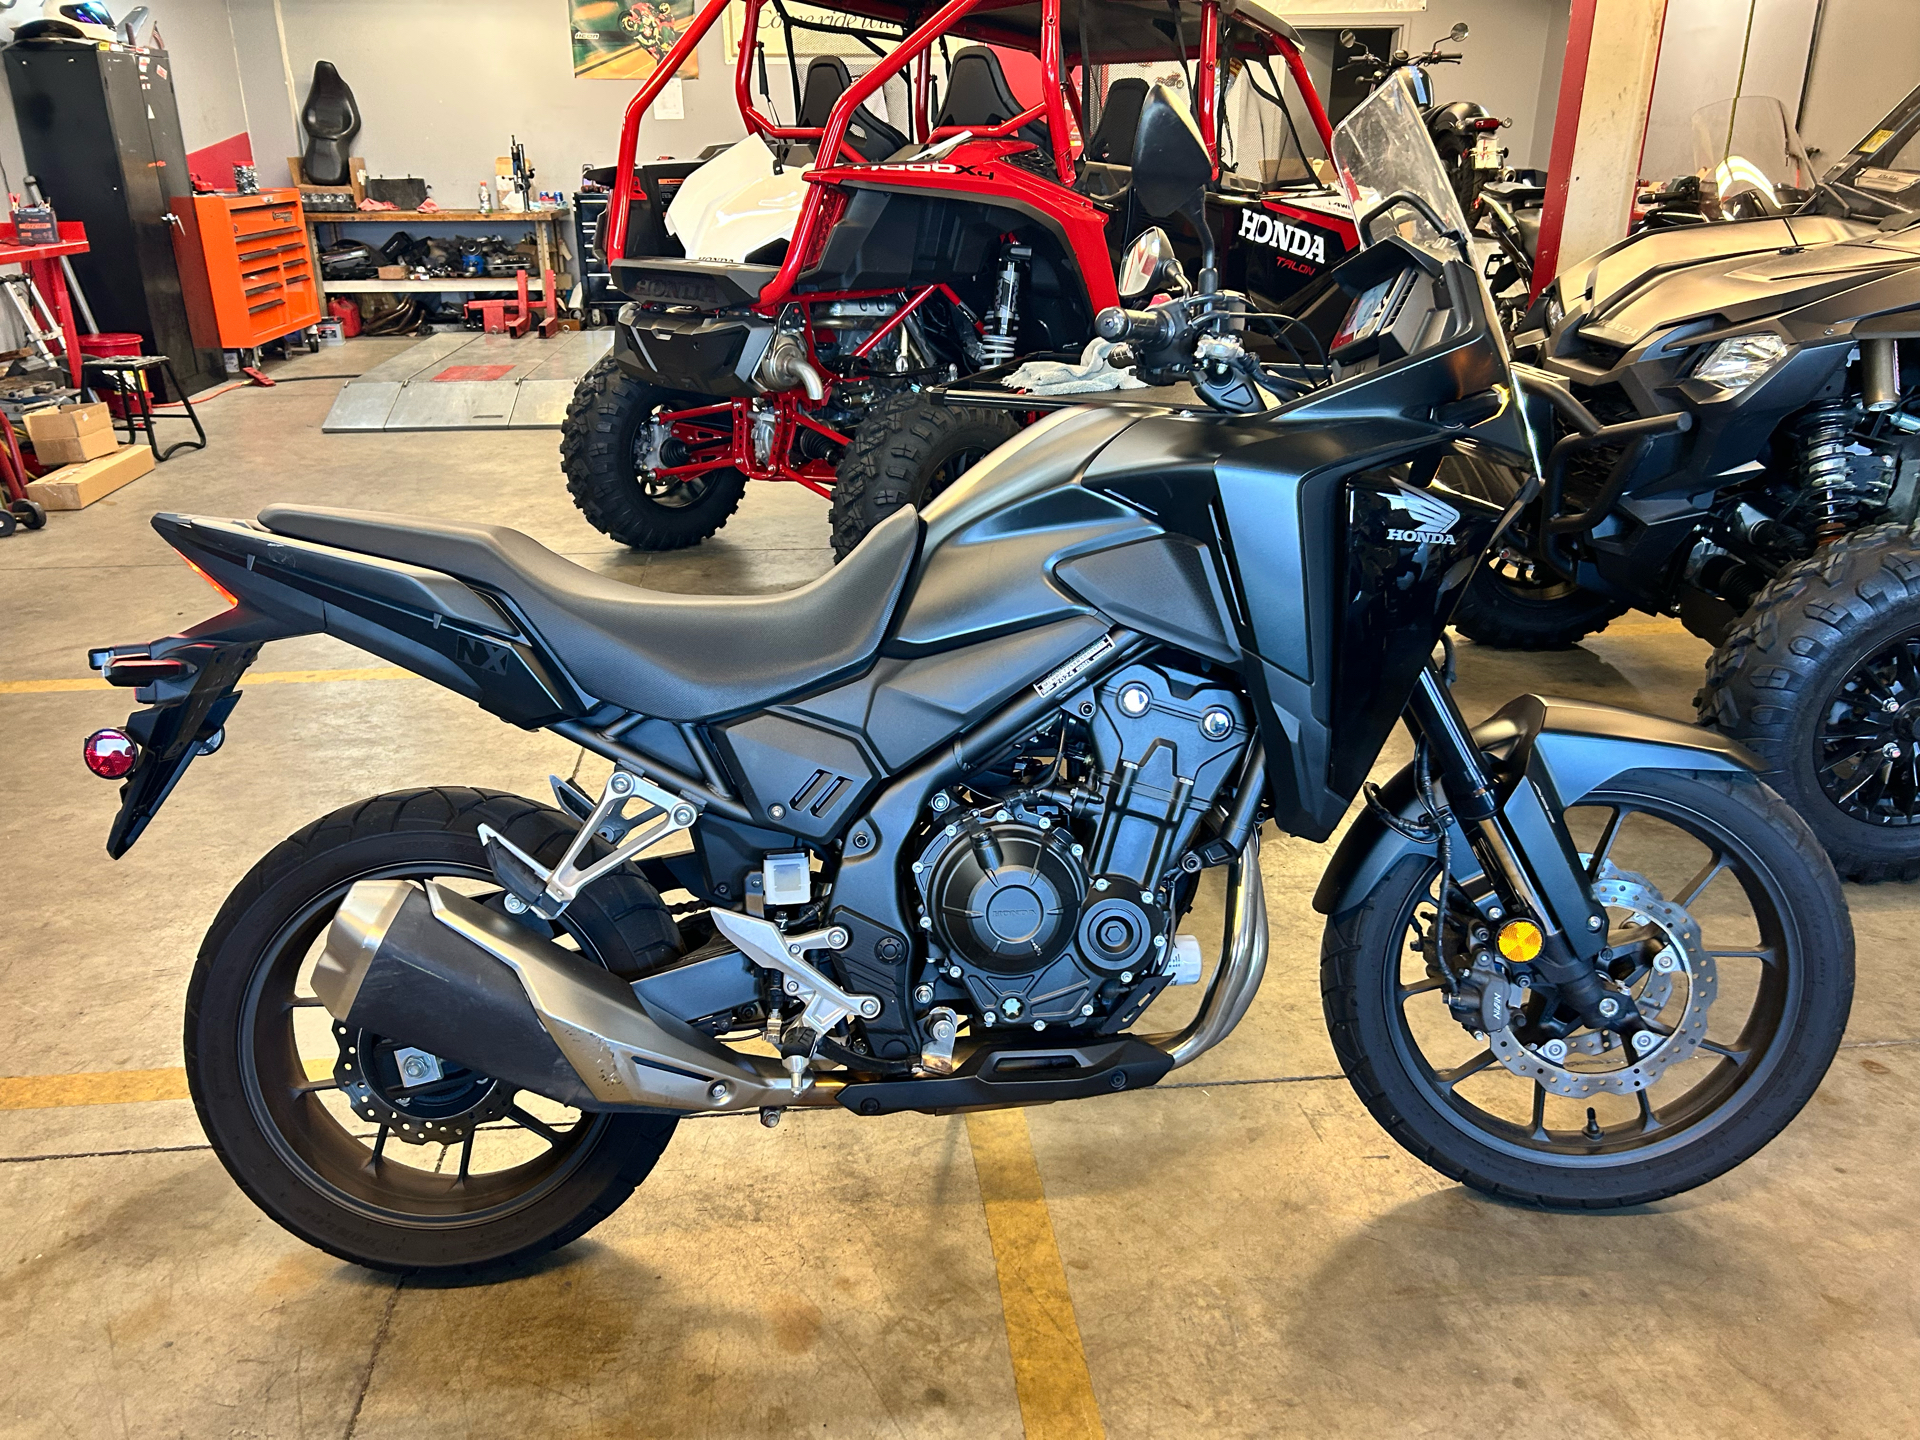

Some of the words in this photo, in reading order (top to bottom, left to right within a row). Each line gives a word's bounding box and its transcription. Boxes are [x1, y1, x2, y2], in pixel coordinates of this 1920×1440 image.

[1238, 208, 1325, 264] HONDA
[1276, 256, 1316, 276] TALON
[635, 279, 718, 303] HONDA
[1386, 529, 1456, 545] HONDA
[457, 634, 510, 676] NX
[992, 909, 1037, 918] HONDA
